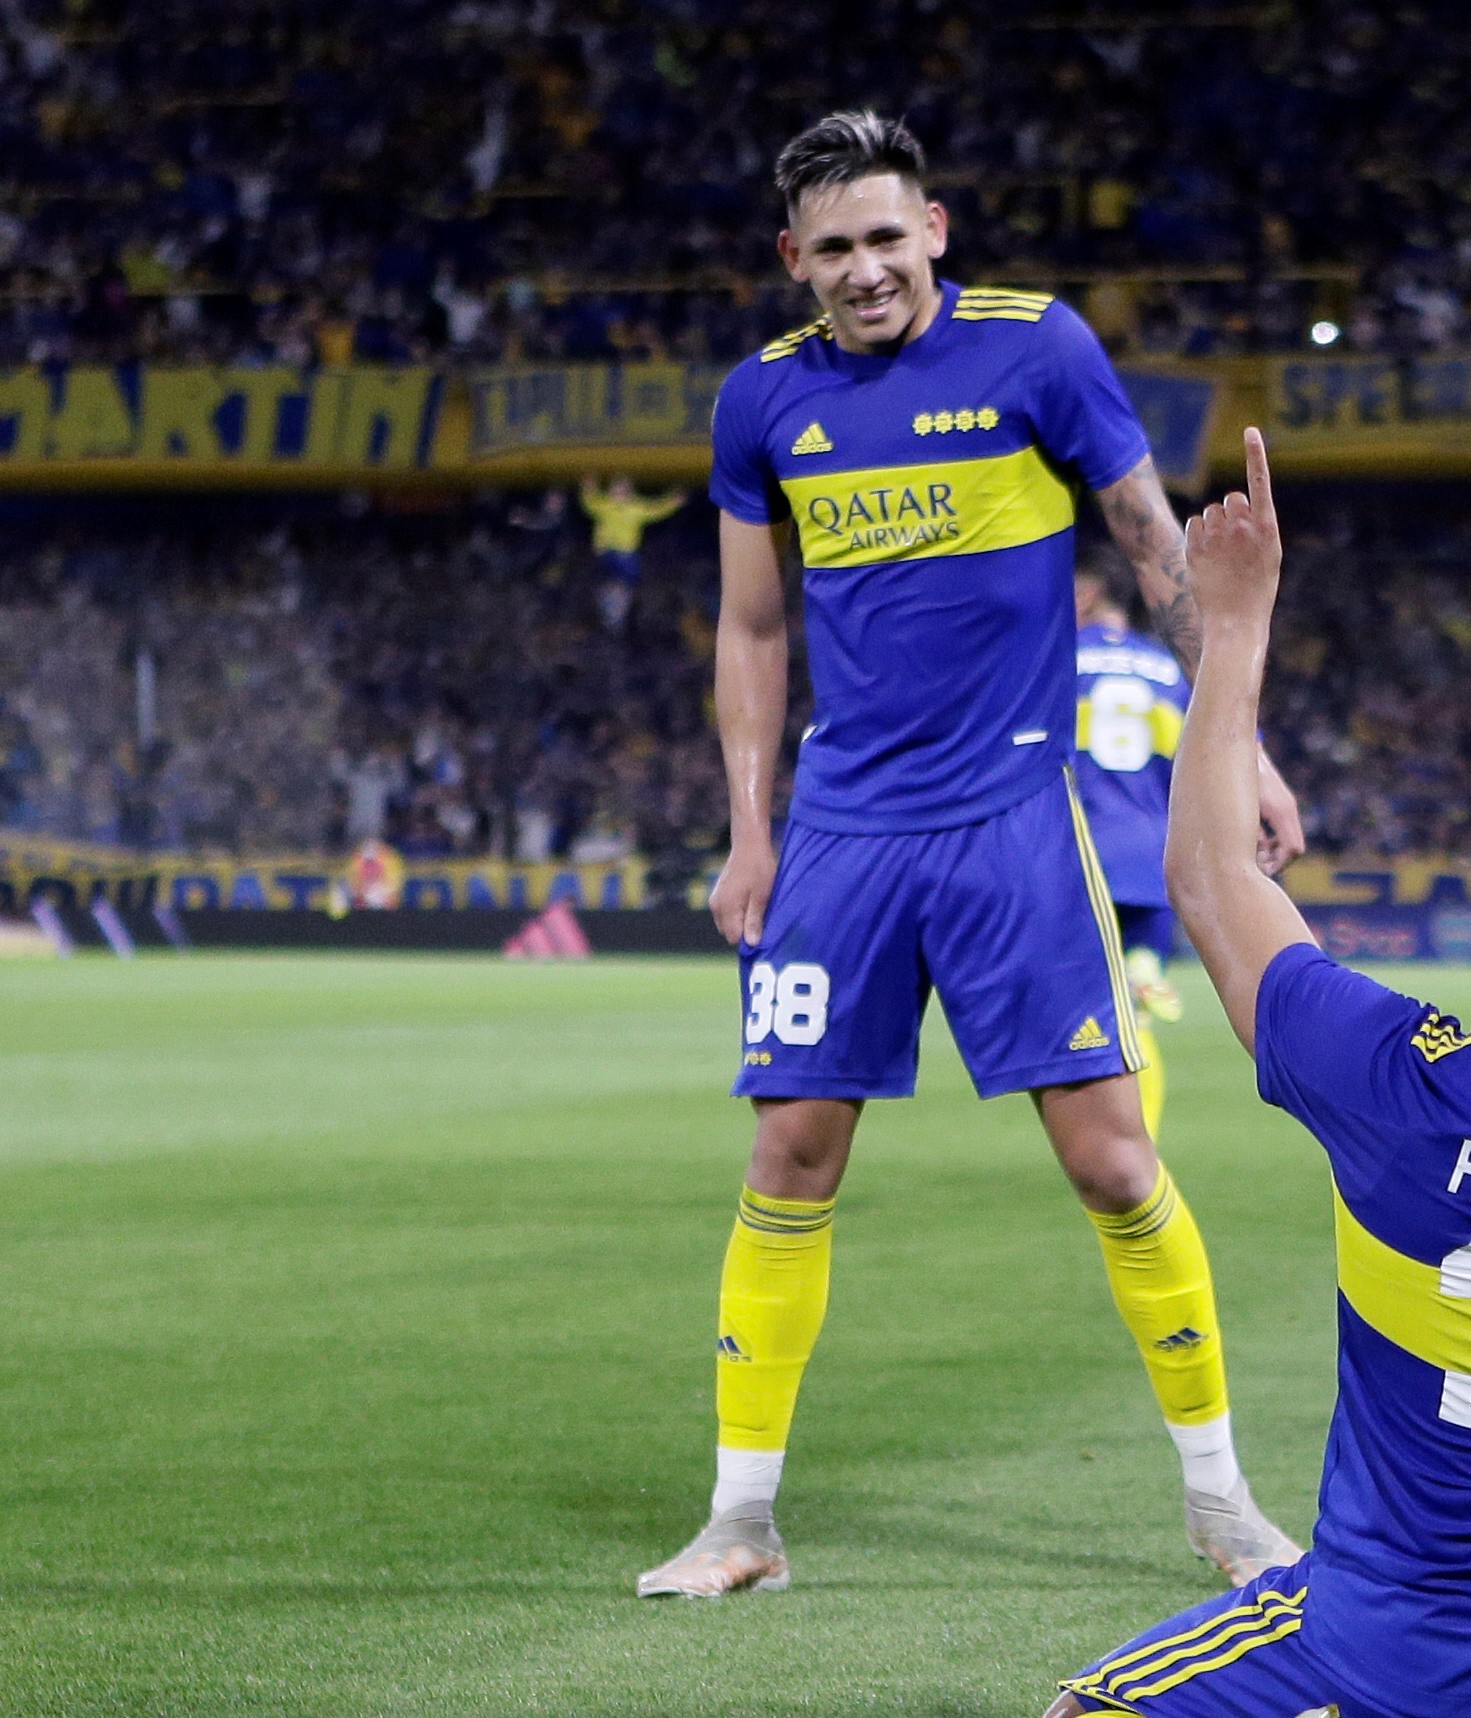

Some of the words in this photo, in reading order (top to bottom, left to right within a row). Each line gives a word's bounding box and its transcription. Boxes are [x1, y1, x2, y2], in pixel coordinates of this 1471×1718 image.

[808, 482, 957, 537] QATAR
[850, 521, 961, 550] AIRWAYS
[1089, 674, 1153, 772] 6
[745, 961, 831, 1046] 38
